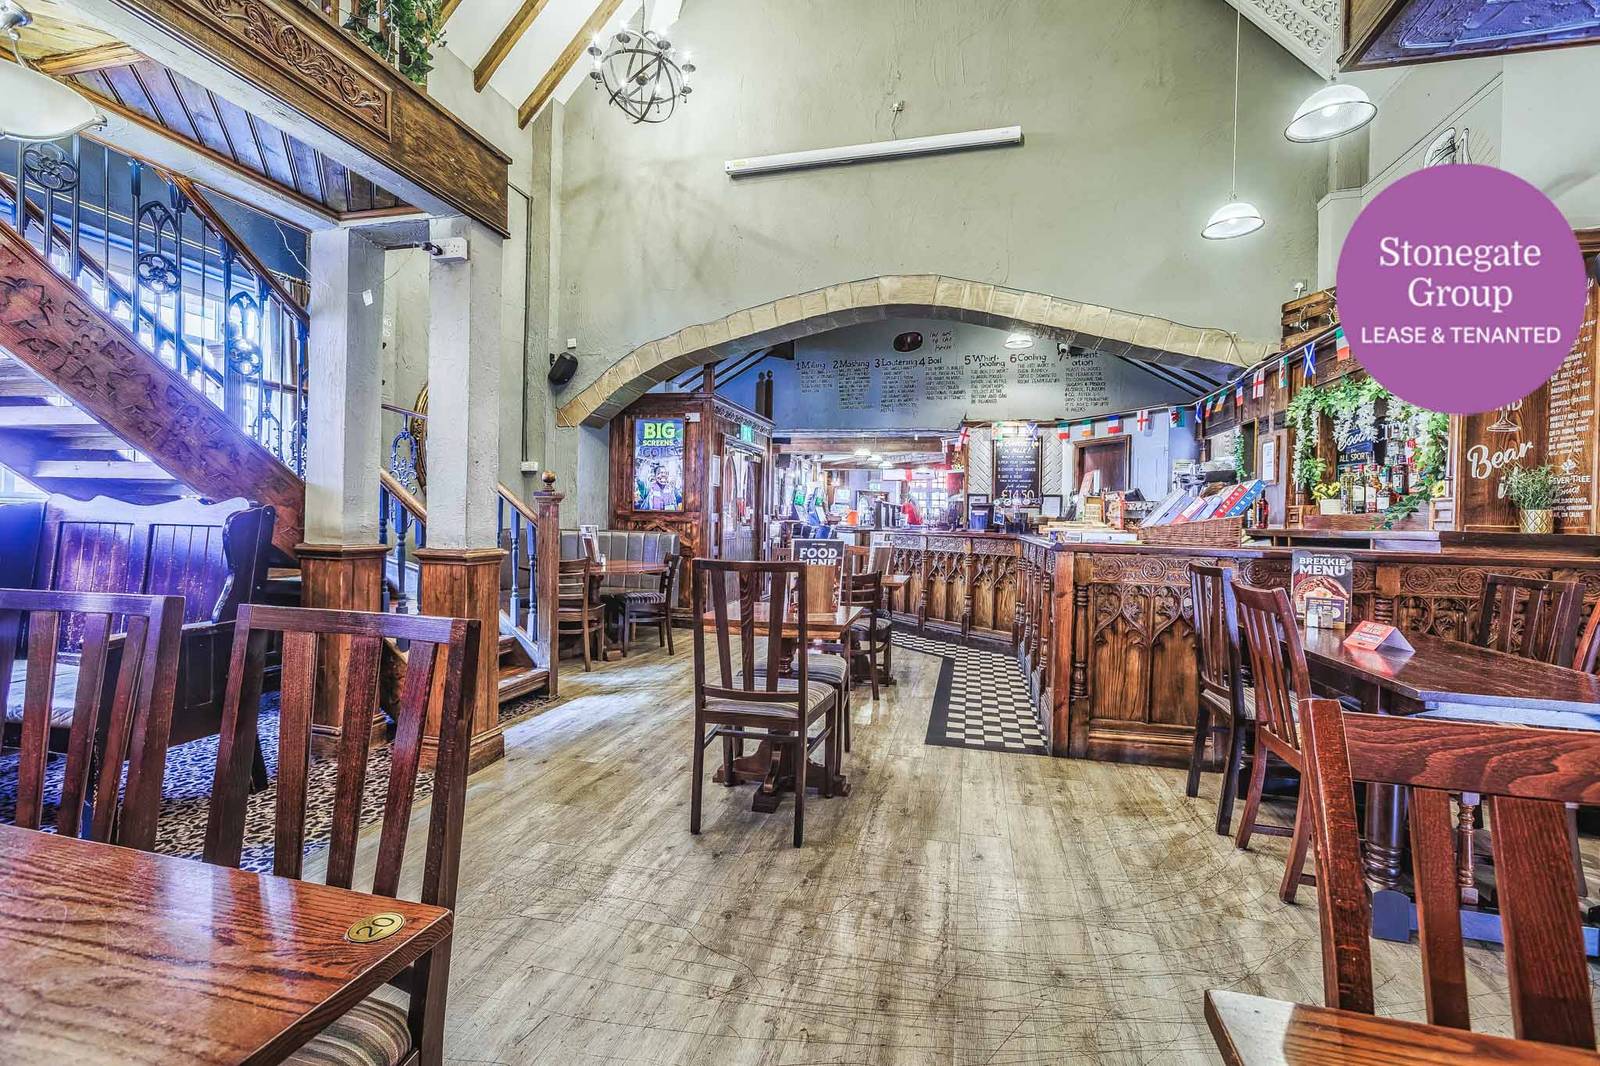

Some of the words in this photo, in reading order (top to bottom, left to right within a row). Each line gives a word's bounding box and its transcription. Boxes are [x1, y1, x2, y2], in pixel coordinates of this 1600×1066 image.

[874, 358, 881, 368] 3
[918, 356, 926, 367] 4
[964, 355, 972, 365] 5
[1009, 354, 1017, 363] 6
[1017, 353, 1047, 363] Cooling
[832, 360, 839, 369] 2
[643, 422, 676, 439] BIG
[642, 439, 674, 447] SCREENS
[1466, 441, 1534, 479] Bear
[799, 547, 838, 559] FOOD
[1299, 556, 1347, 566] BREKKIE
[1299, 564, 1346, 577] MENU
[356, 917, 395, 938] 20
